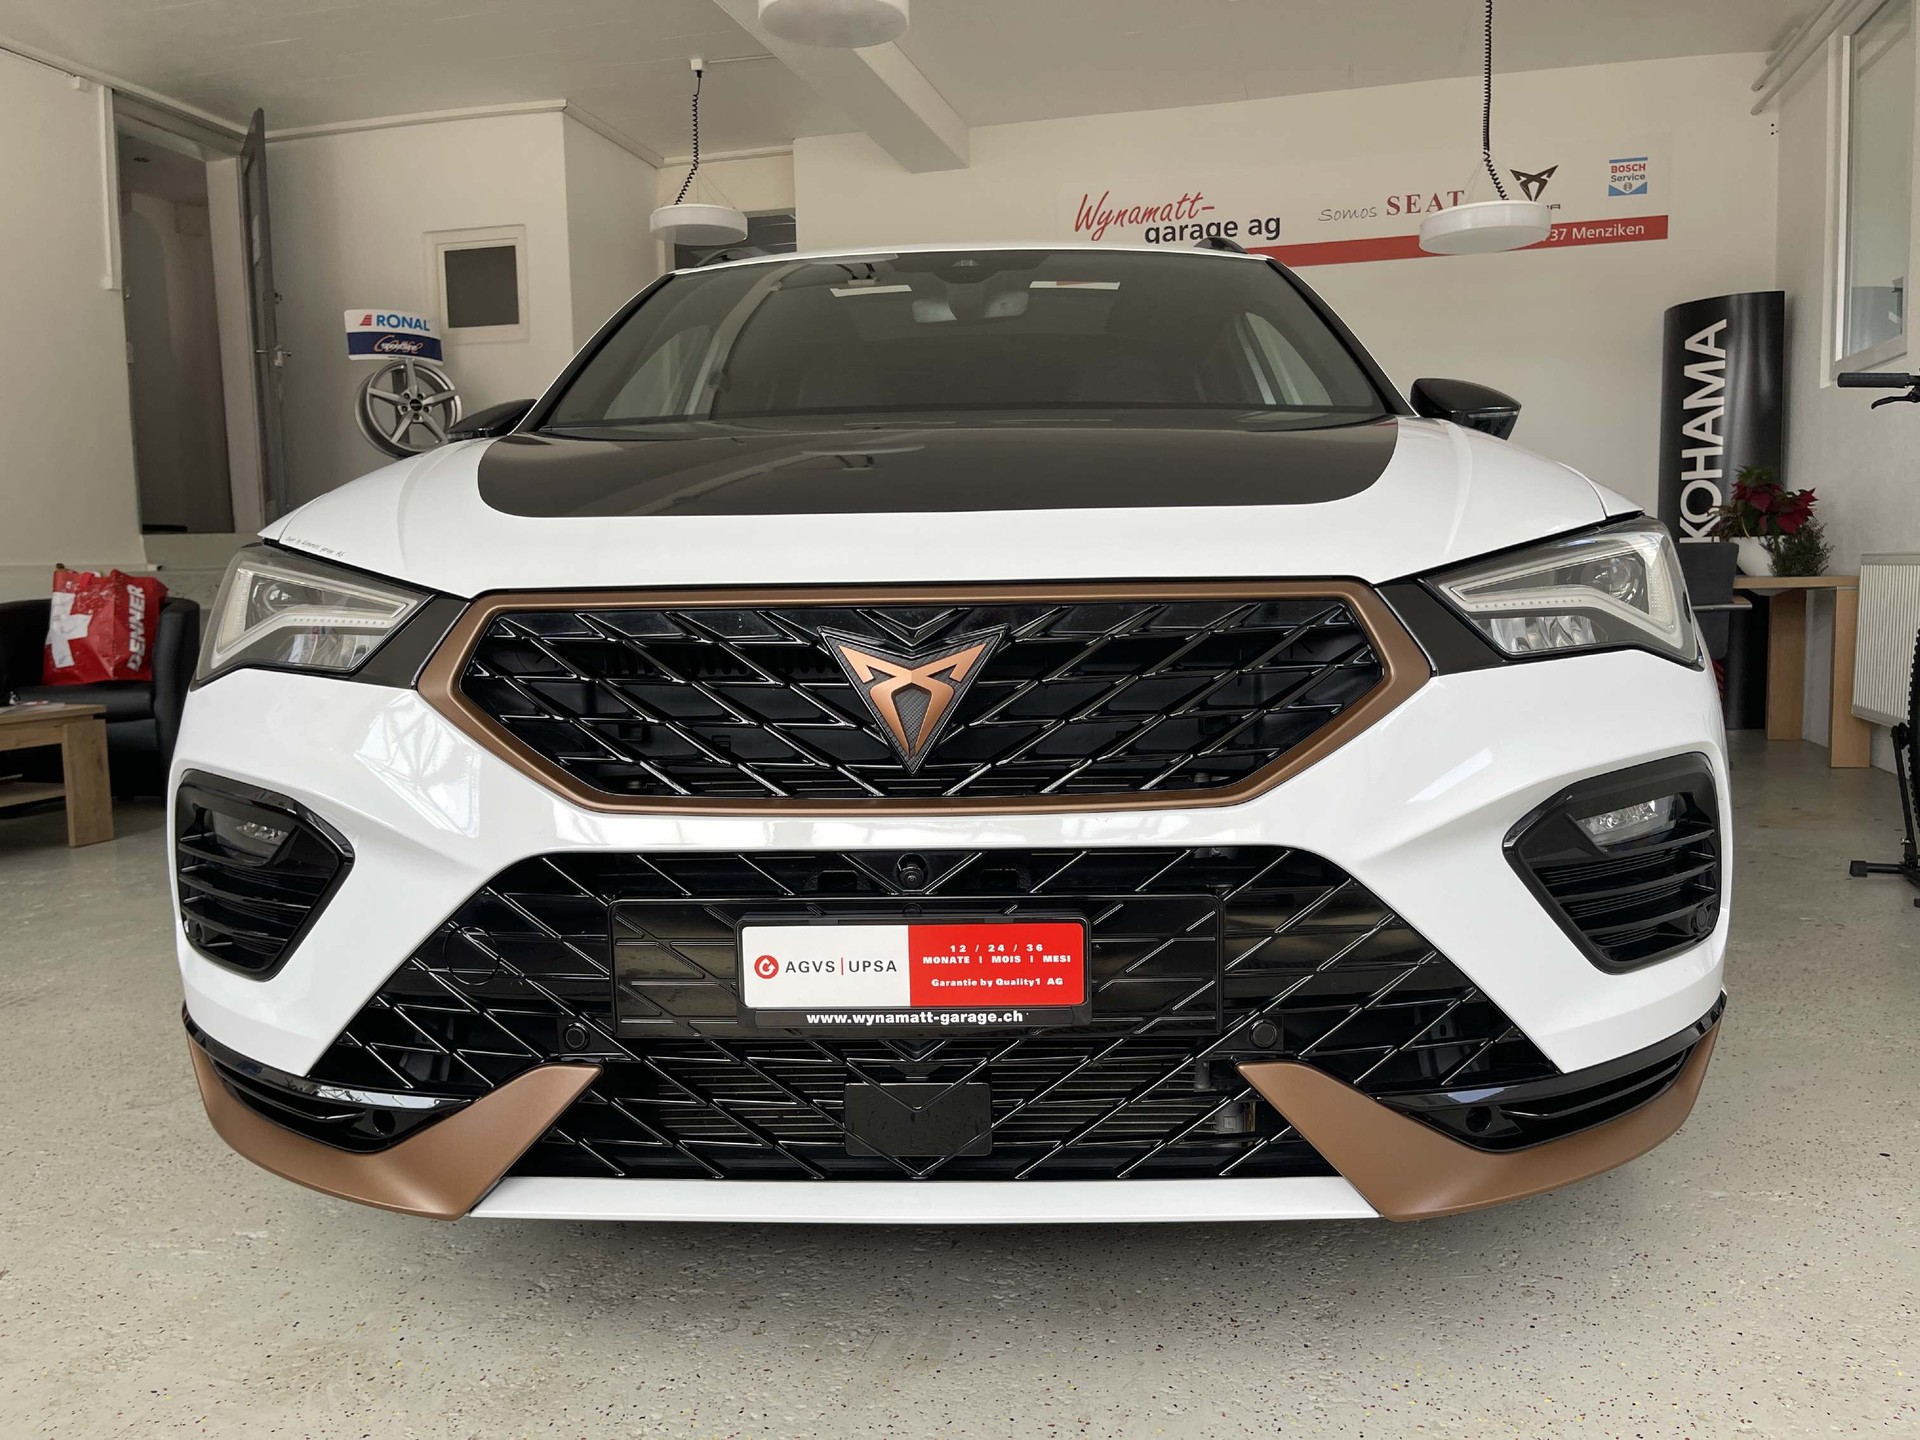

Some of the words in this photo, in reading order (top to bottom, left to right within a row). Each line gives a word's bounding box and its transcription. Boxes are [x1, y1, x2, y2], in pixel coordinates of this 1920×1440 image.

[1611, 163, 1646, 174] BOSCH
[1610, 173, 1646, 183] Service
[1318, 206, 1378, 222] Somos
[1386, 190, 1465, 216] SEAT
[1074, 191, 1216, 242] Wynamatt-
[1144, 219, 1238, 244] garage
[1247, 216, 1281, 241] ag
[1548, 228, 1567, 242] 37
[1571, 223, 1645, 239] Menziken
[376, 314, 430, 332] RONAL
[126, 584, 146, 671] DENNER
[950, 944, 967, 953] 12
[987, 944, 1005, 952] 24
[1026, 943, 1044, 952] 36
[785, 960, 835, 973] AGVS
[848, 960, 897, 973] UPSA
[922, 955, 971, 964] MONATE
[991, 955, 1022, 964] MOIS
[1042, 954, 1071, 963] MESI
[931, 978, 978, 987] Garantie
[979, 978, 993, 988] by
[995, 977, 1041, 988] Quality1
[1046, 977, 1064, 986] AG
[805, 1010, 1024, 1026] www.wynamatt-garage.ch
